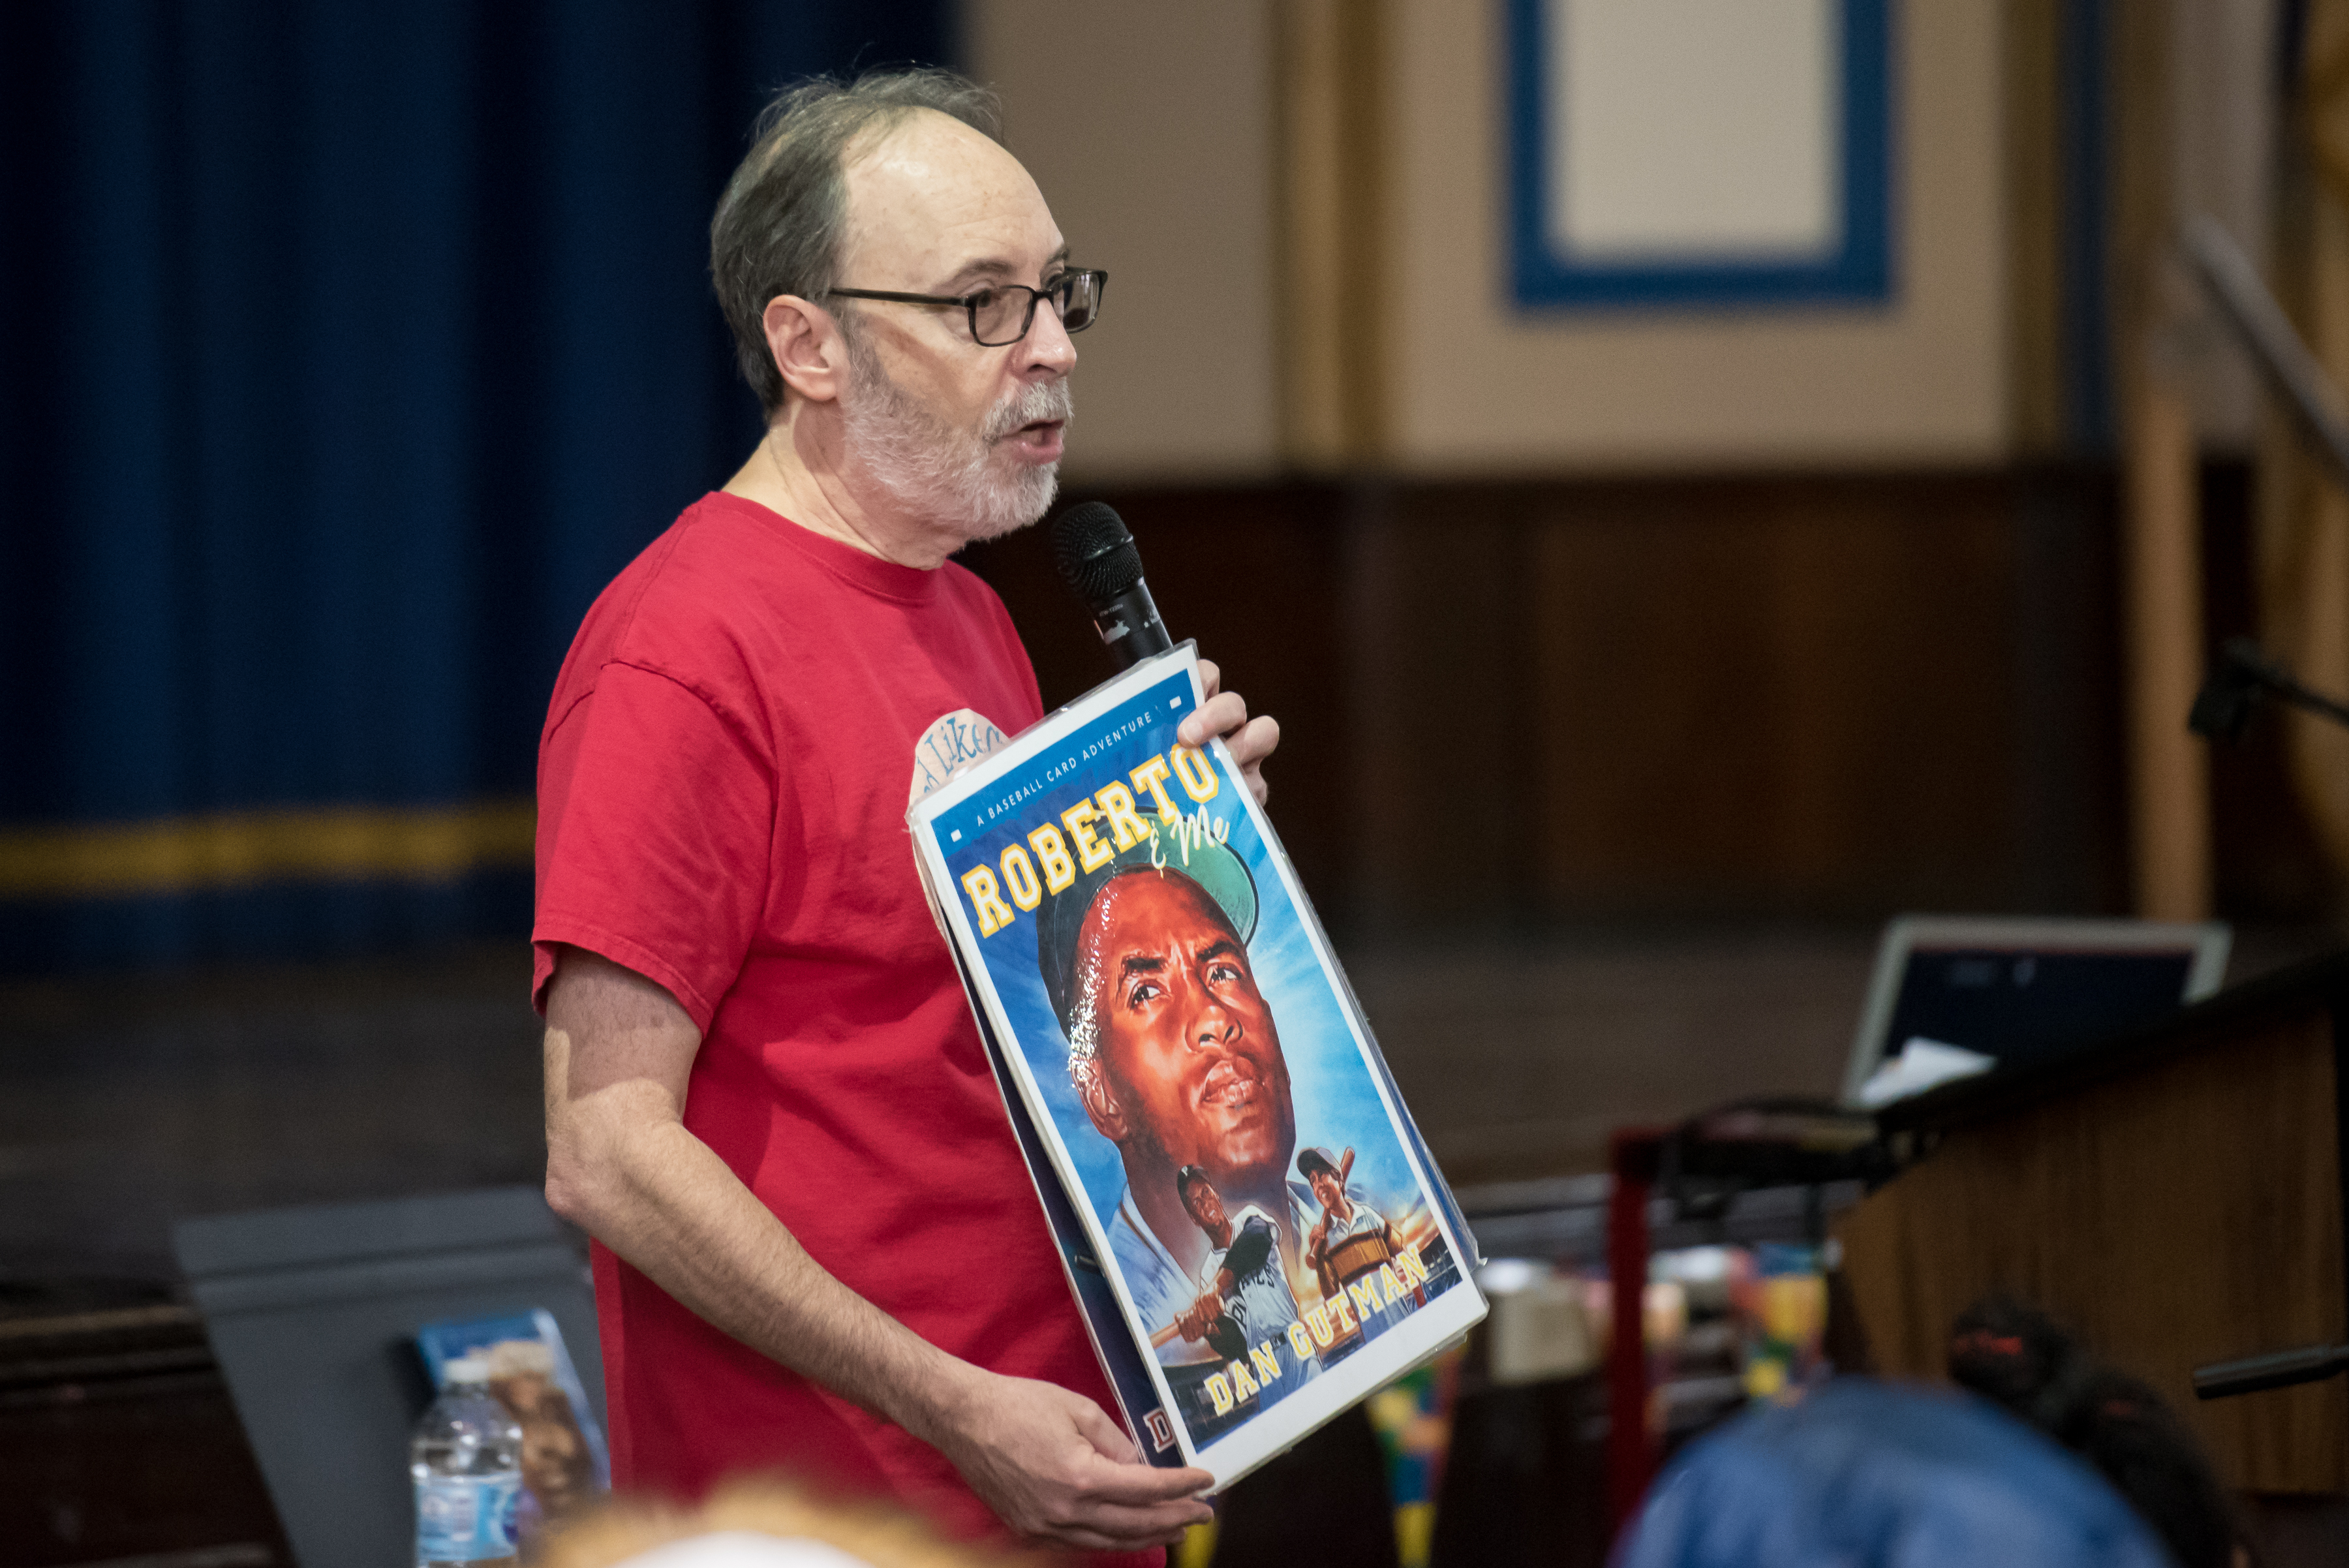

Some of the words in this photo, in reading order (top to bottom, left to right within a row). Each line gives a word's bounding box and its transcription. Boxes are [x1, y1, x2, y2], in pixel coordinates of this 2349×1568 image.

[960, 743, 1220, 938] ROBERTO
[977, 815, 985, 827] A
[987, 778, 1043, 819] BASEBALL
[1047, 757, 1077, 782] CARD
[1082, 711, 1152, 761] ADVENTURE
[1170, 803, 1230, 867] Me
[1203, 1340, 1282, 1417] DAN
[1287, 1240, 1429, 1360] GUTMAN
